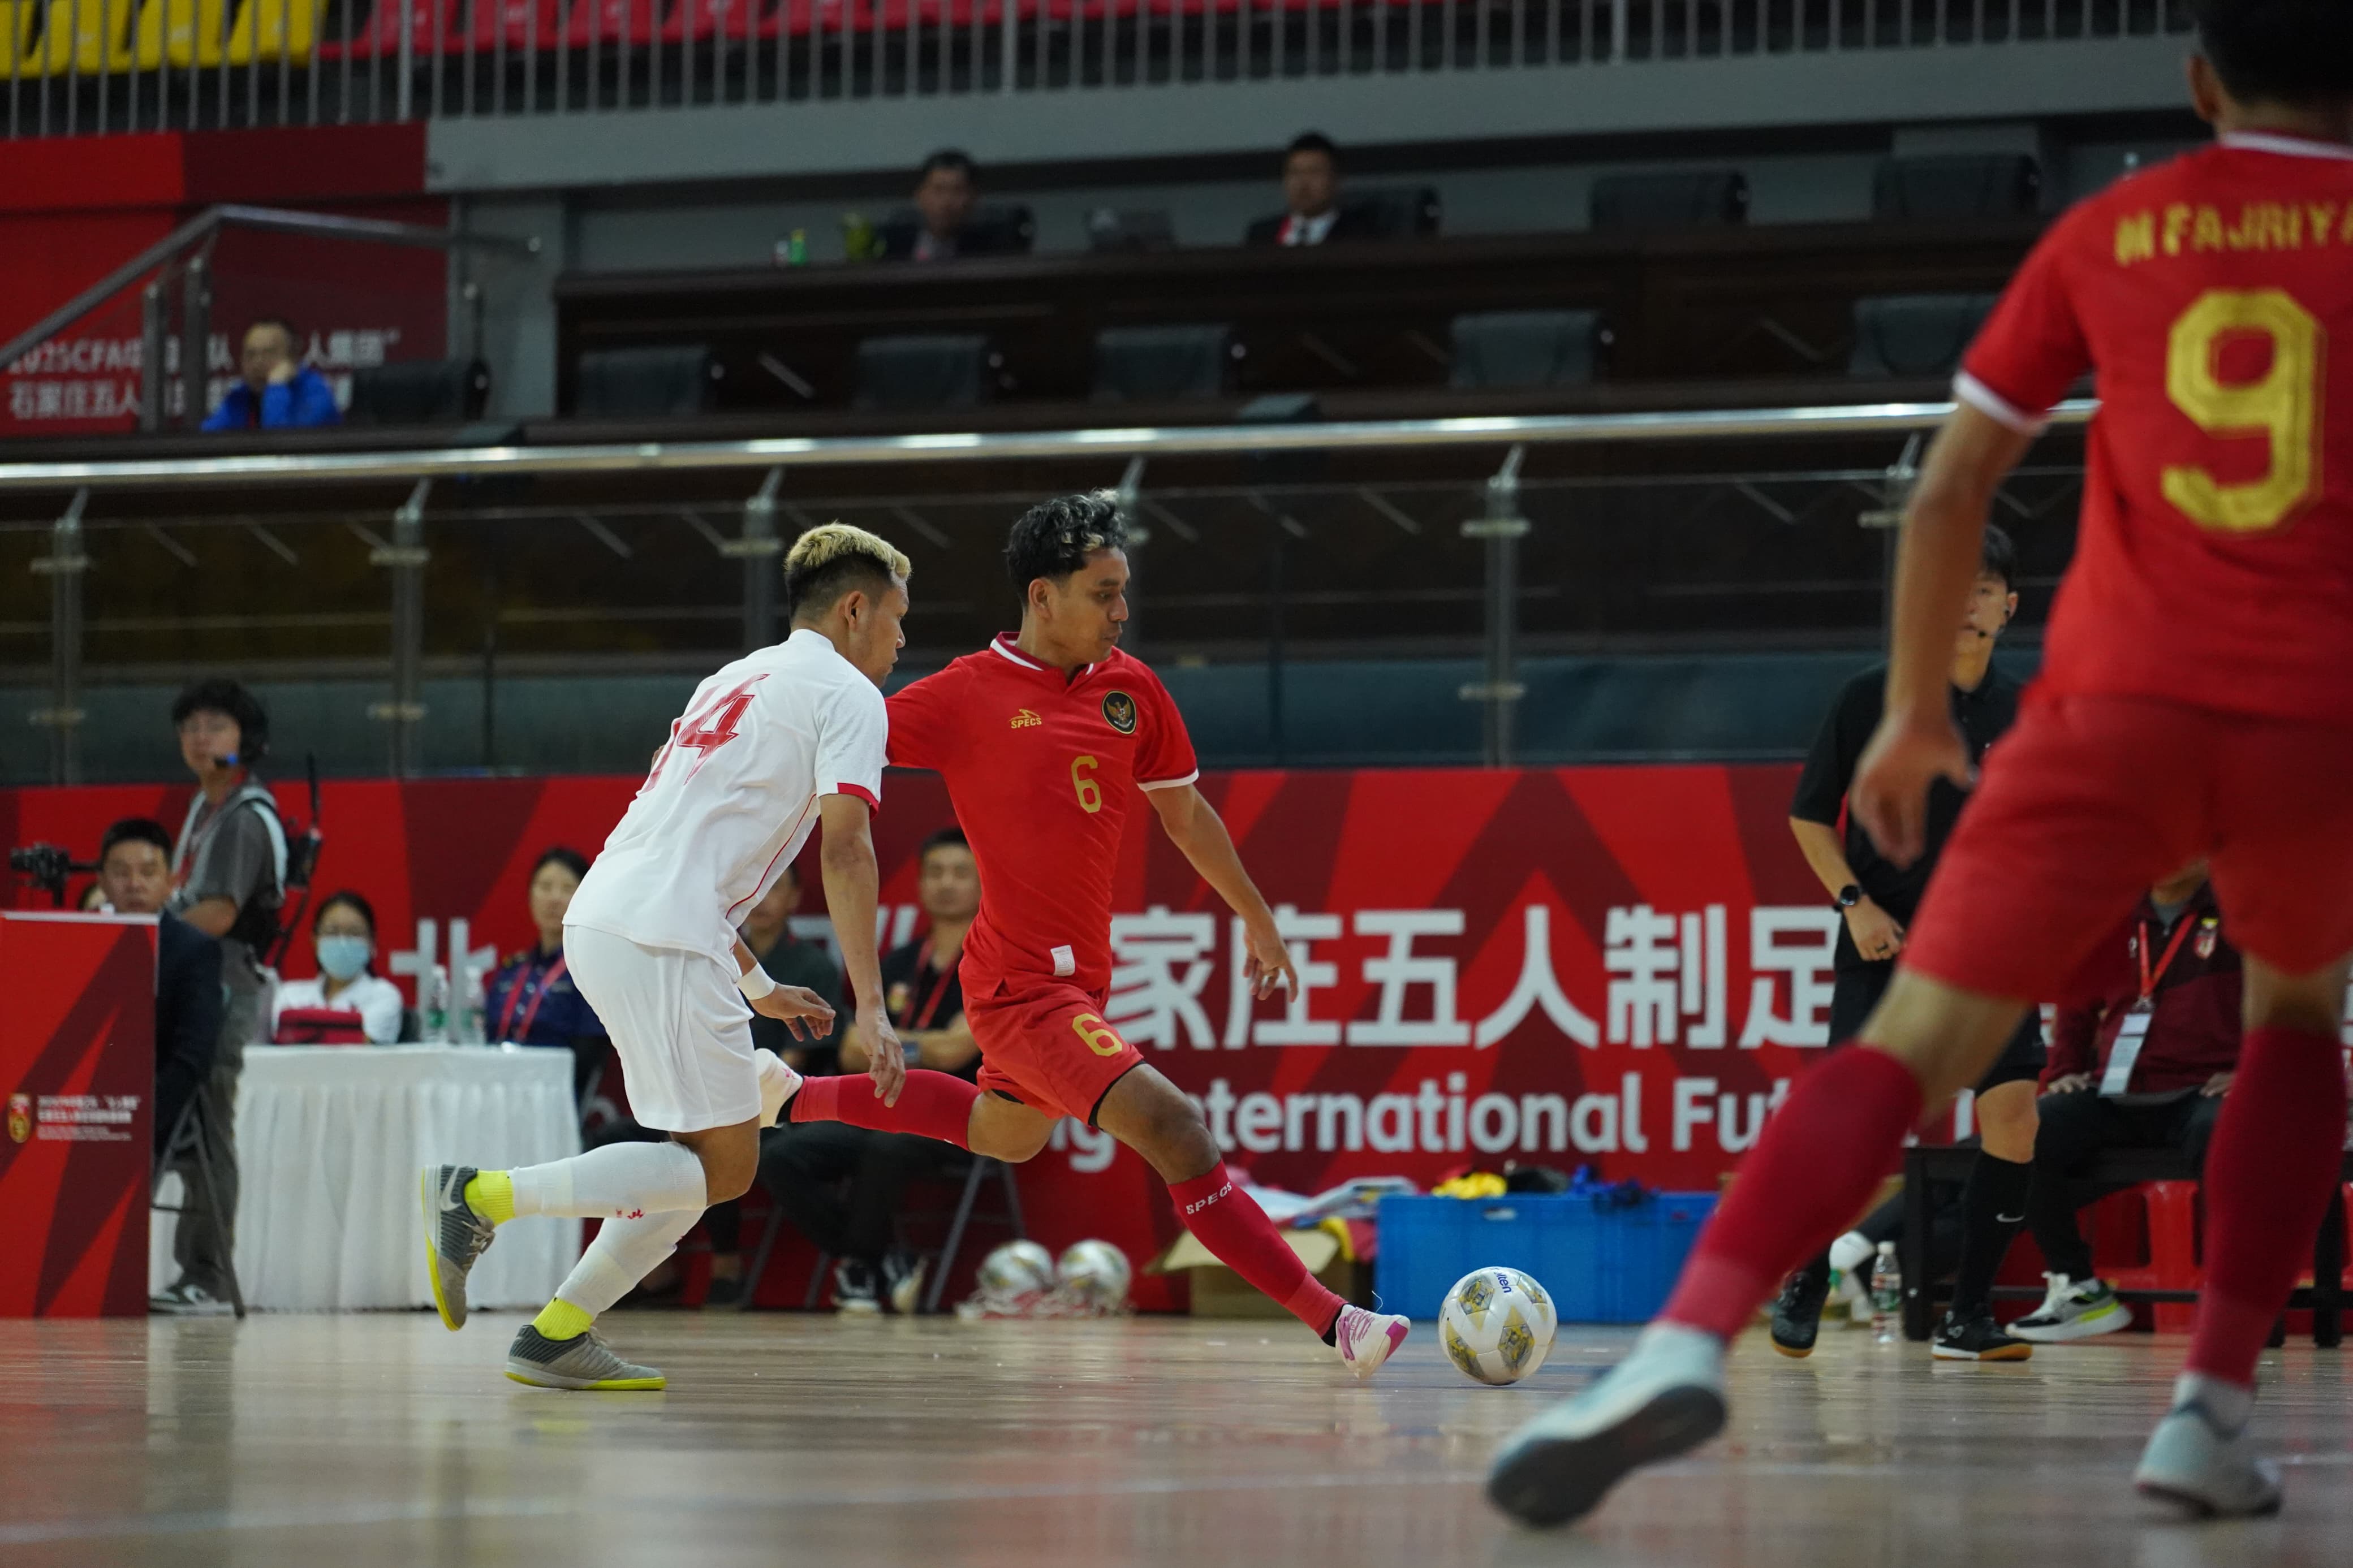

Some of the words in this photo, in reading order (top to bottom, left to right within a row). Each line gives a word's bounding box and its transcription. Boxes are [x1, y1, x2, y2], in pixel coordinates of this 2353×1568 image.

[2161, 287, 2321, 532] 9
[1011, 717, 1042, 729] SPECS
[1071, 755, 1102, 814] 6
[1072, 1013, 1123, 1057] 6
[1186, 1181, 1232, 1215] SPECS
